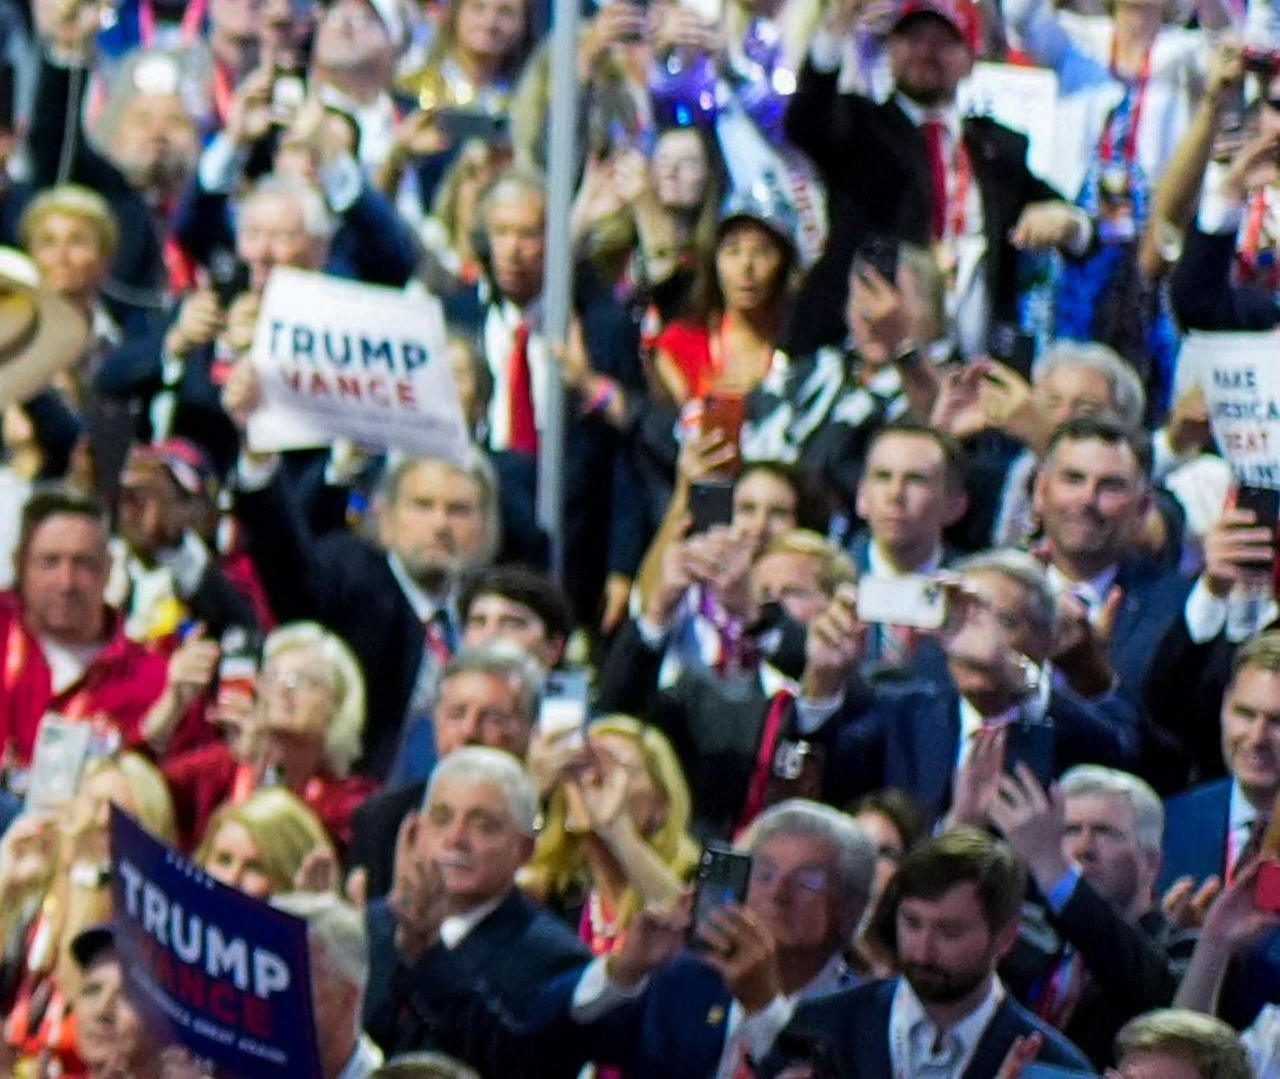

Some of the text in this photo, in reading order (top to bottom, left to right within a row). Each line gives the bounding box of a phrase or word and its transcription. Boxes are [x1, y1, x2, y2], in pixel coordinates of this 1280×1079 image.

[270, 319, 430, 372] TRUMP
[280, 370, 417, 409] VANCE
[120, 858, 290, 1000] TRUMP
